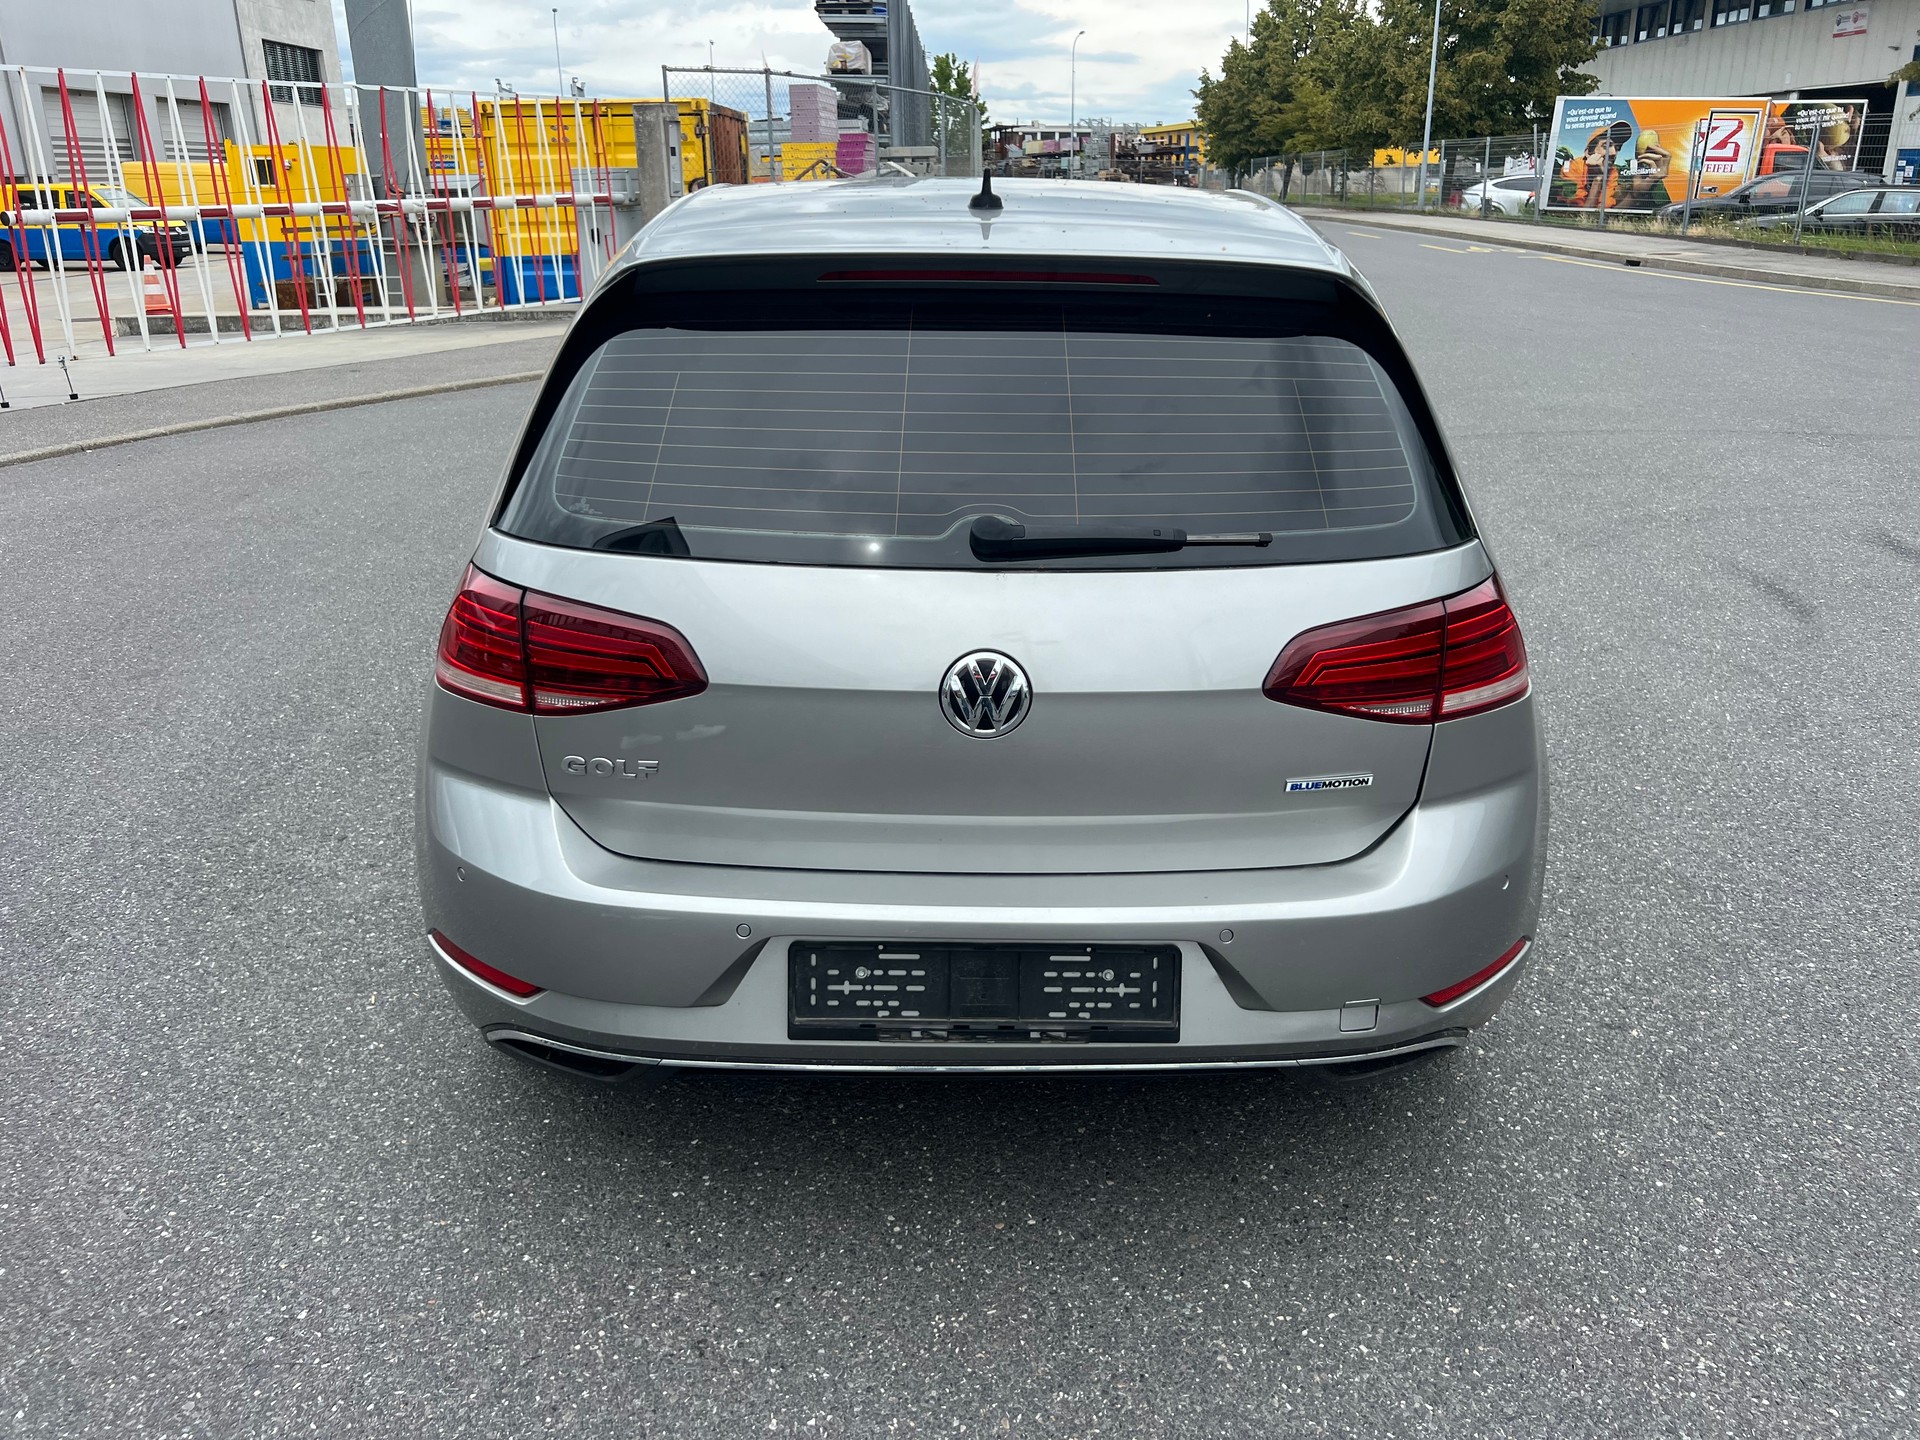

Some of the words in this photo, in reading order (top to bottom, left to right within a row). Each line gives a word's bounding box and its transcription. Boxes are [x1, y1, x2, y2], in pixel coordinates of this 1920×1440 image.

[1600, 112, 1617, 120] quand
[1586, 120, 1604, 128] grande
[561, 755, 659, 779] GOLF
[1290, 778, 1369, 791] BLUEMOTION
